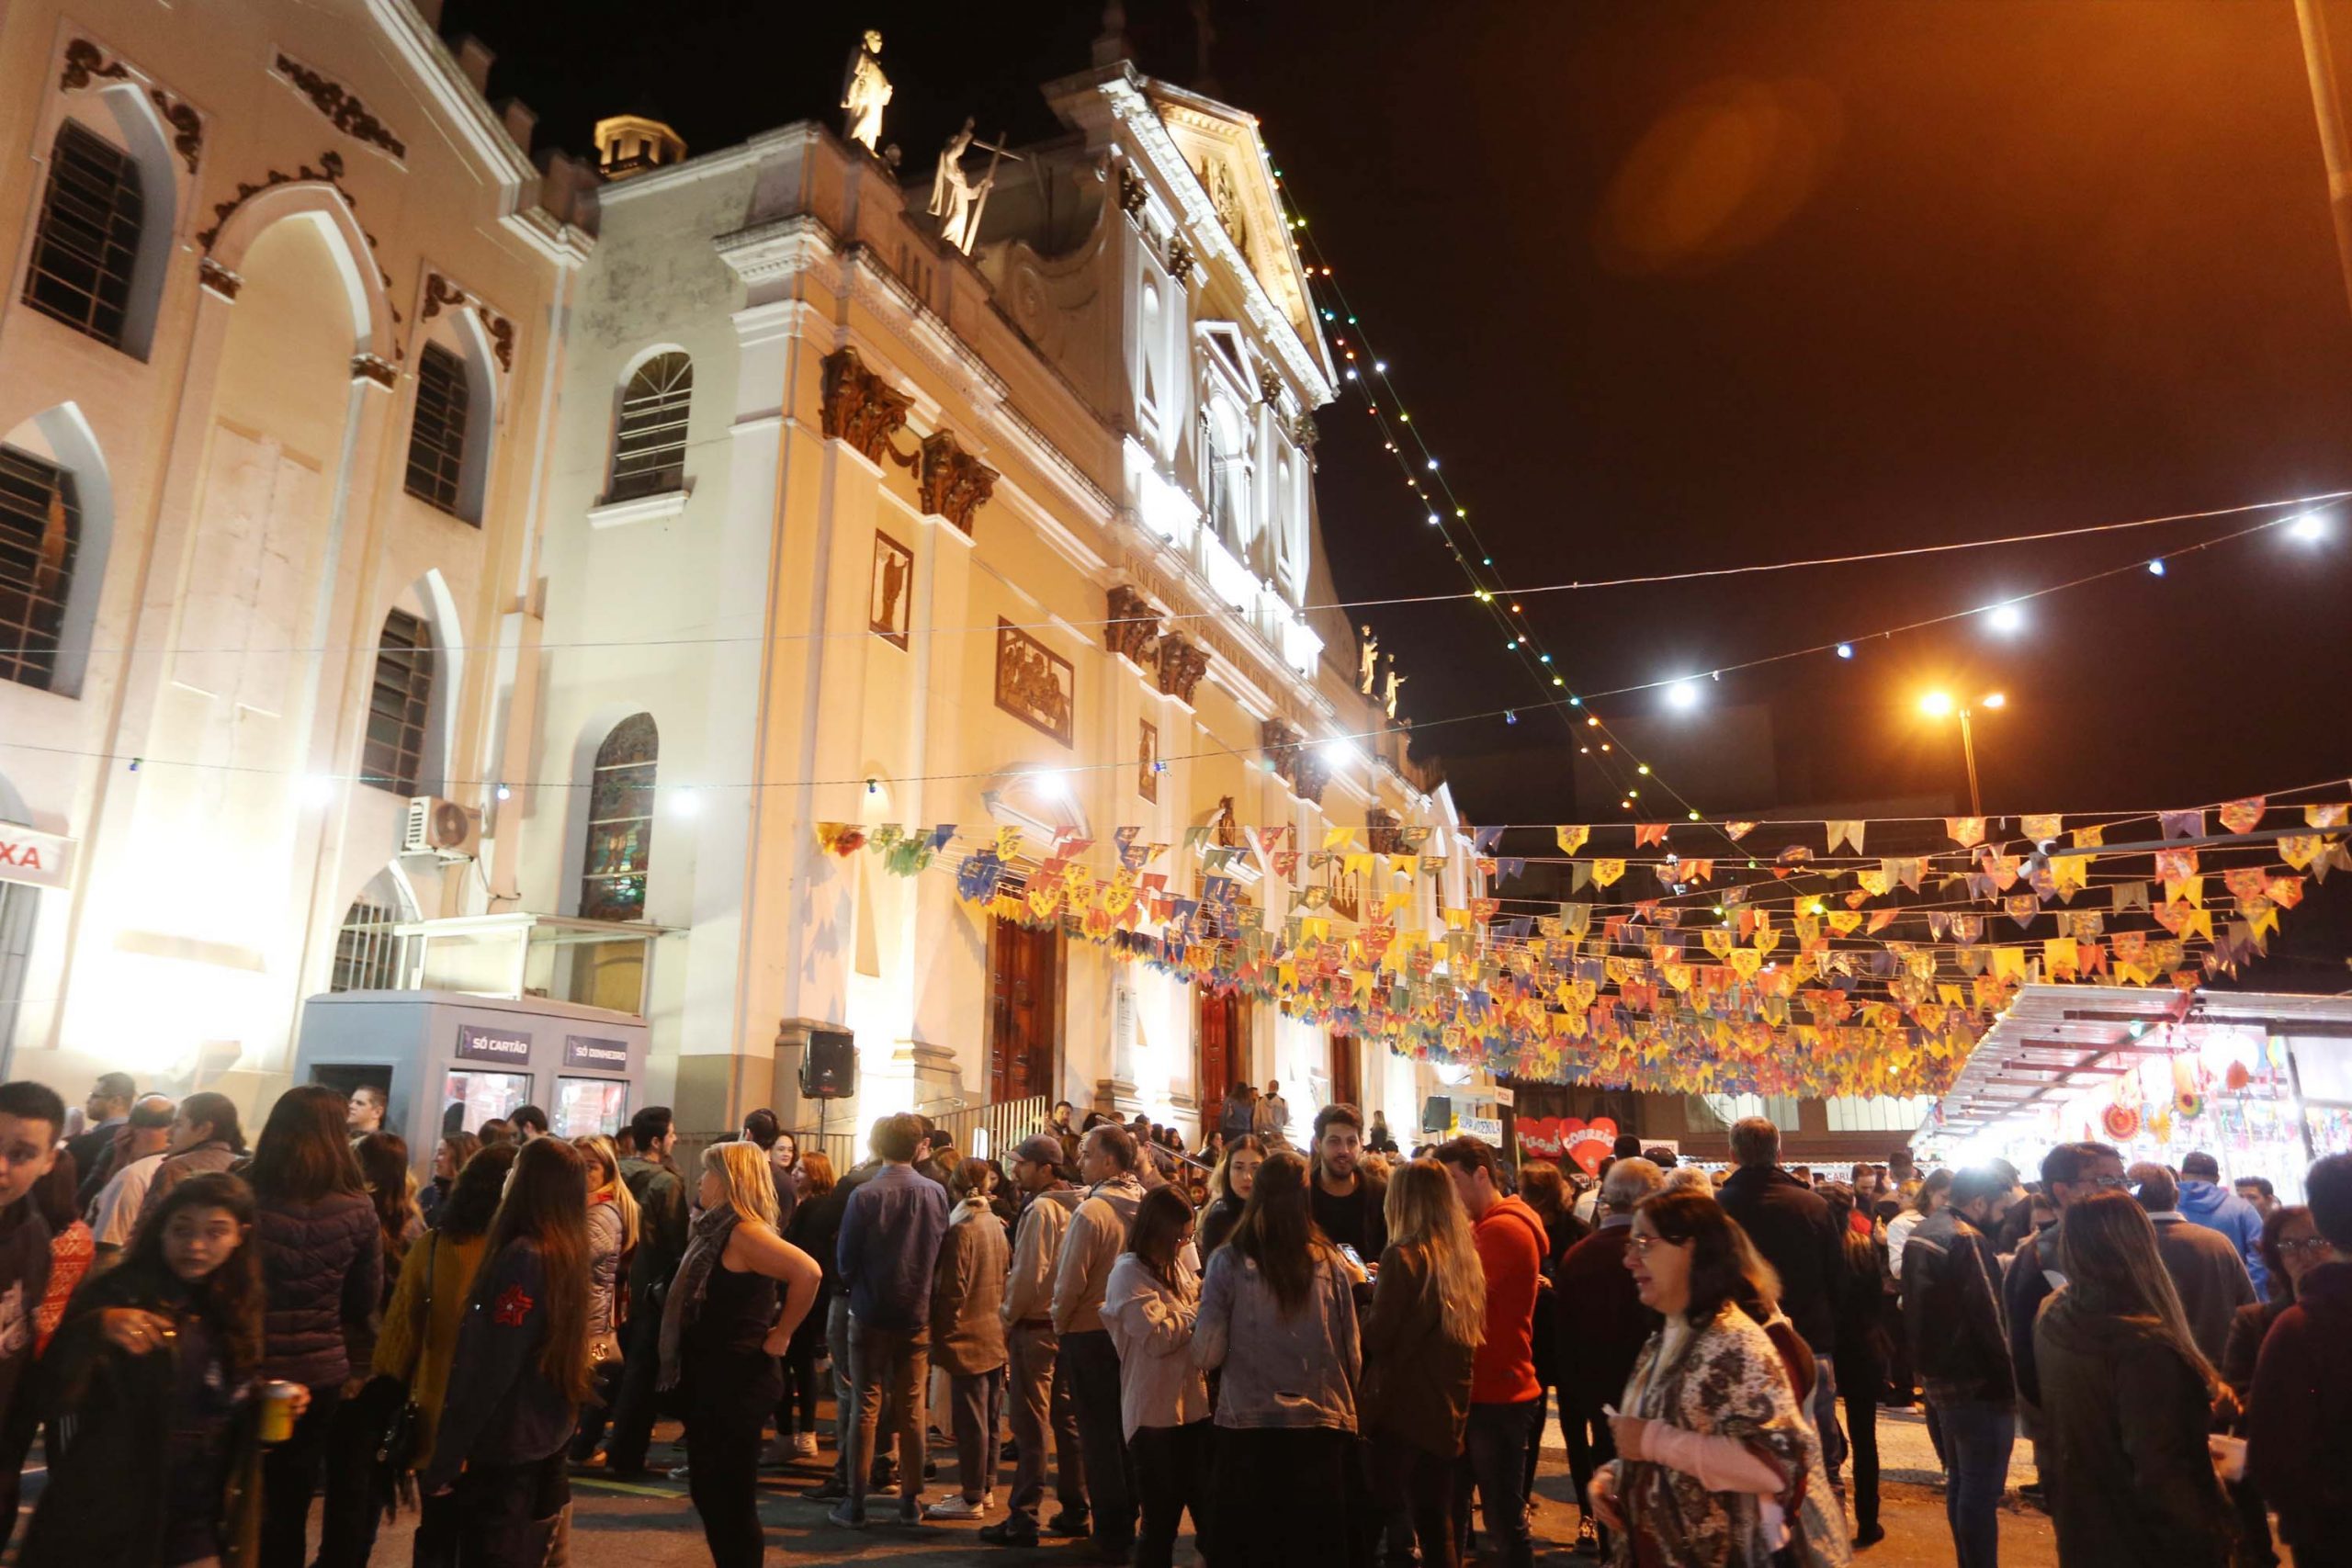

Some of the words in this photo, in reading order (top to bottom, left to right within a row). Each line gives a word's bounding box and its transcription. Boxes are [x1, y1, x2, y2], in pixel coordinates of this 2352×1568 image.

[472, 1036, 488, 1050] SÓ
[489, 1040, 528, 1055] CARTÃO
[576, 1045, 588, 1057] SÓ
